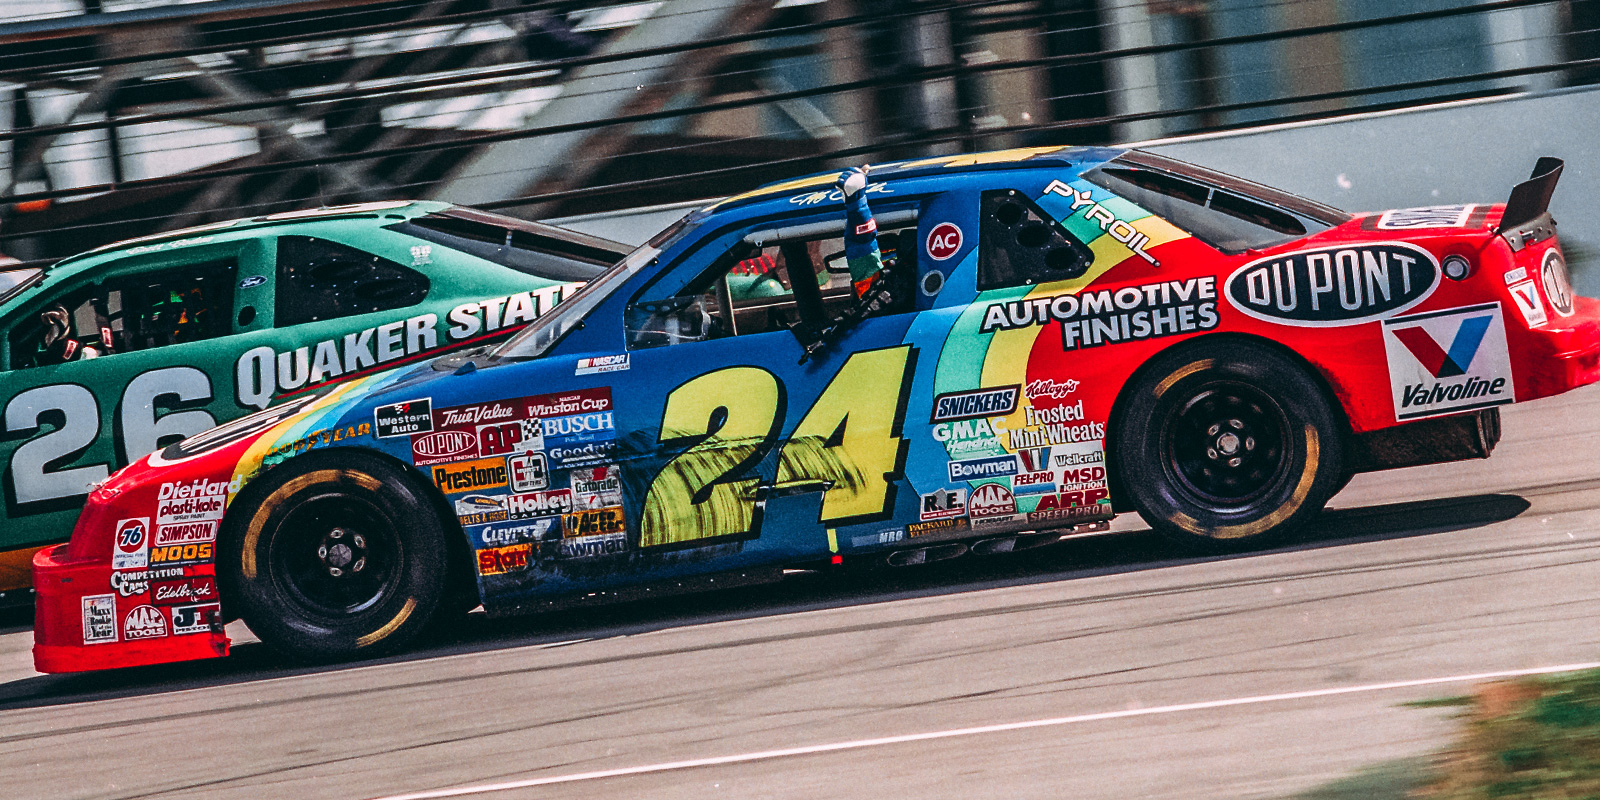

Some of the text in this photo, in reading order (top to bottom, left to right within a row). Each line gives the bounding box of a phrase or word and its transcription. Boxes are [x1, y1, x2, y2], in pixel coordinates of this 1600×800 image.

[1042, 179, 1157, 265] PYROIL
[931, 233, 957, 251] AC
[1306, 249, 1416, 311] PONT
[982, 276, 1216, 331] AUTOMOTIVE
[1063, 303, 1219, 348] FINISHES
[236, 316, 438, 410] QUAKER
[592, 354, 626, 367] NASCAR
[1025, 379, 1079, 399] Kellogg's
[1401, 376, 1506, 408] Valvoline
[528, 398, 609, 417] Winston Cup
[937, 390, 1014, 418] SNICKERS
[1024, 400, 1084, 427] Frosted
[378, 413, 430, 426] Western
[391, 423, 420, 434] Auto
[543, 412, 614, 437] BUSCH
[932, 417, 1008, 442] GMAC
[4, 364, 218, 506] 26
[480, 424, 522, 456] AP
[1009, 421, 1105, 450] Mini-Wheats
[638, 343, 912, 549] 24
[415, 453, 478, 467] AUTOMOTIVE FINISHES
[951, 460, 1017, 477] Bowman
[1055, 451, 1104, 467] Wellcraft
[435, 465, 507, 490] Prestone
[575, 478, 619, 493] Gatorade
[1014, 471, 1055, 486] FEL-PRO
[1063, 467, 1106, 485] MSD
[158, 474, 242, 500] DieHard
[971, 486, 1013, 508] MAC
[1063, 481, 1104, 493] IGNITION
[160, 498, 222, 517] plasti-kote
[509, 493, 572, 514] Holley
[971, 505, 1014, 515] TOOLS
[1035, 488, 1109, 512] ARP
[460, 510, 508, 525] BELTS & HOSE
[1030, 505, 1099, 520] SPEED-PRO
[160, 523, 212, 542] SIMPSON
[909, 520, 953, 531] PACKARD
[120, 525, 143, 547] 76
[110, 567, 184, 588] COMPETITION
[120, 581, 149, 597] CAMS
[156, 583, 211, 600] Edelbrck
[127, 607, 164, 630] MAC
[91, 626, 112, 637] Year
[127, 628, 166, 639] TOOLS
